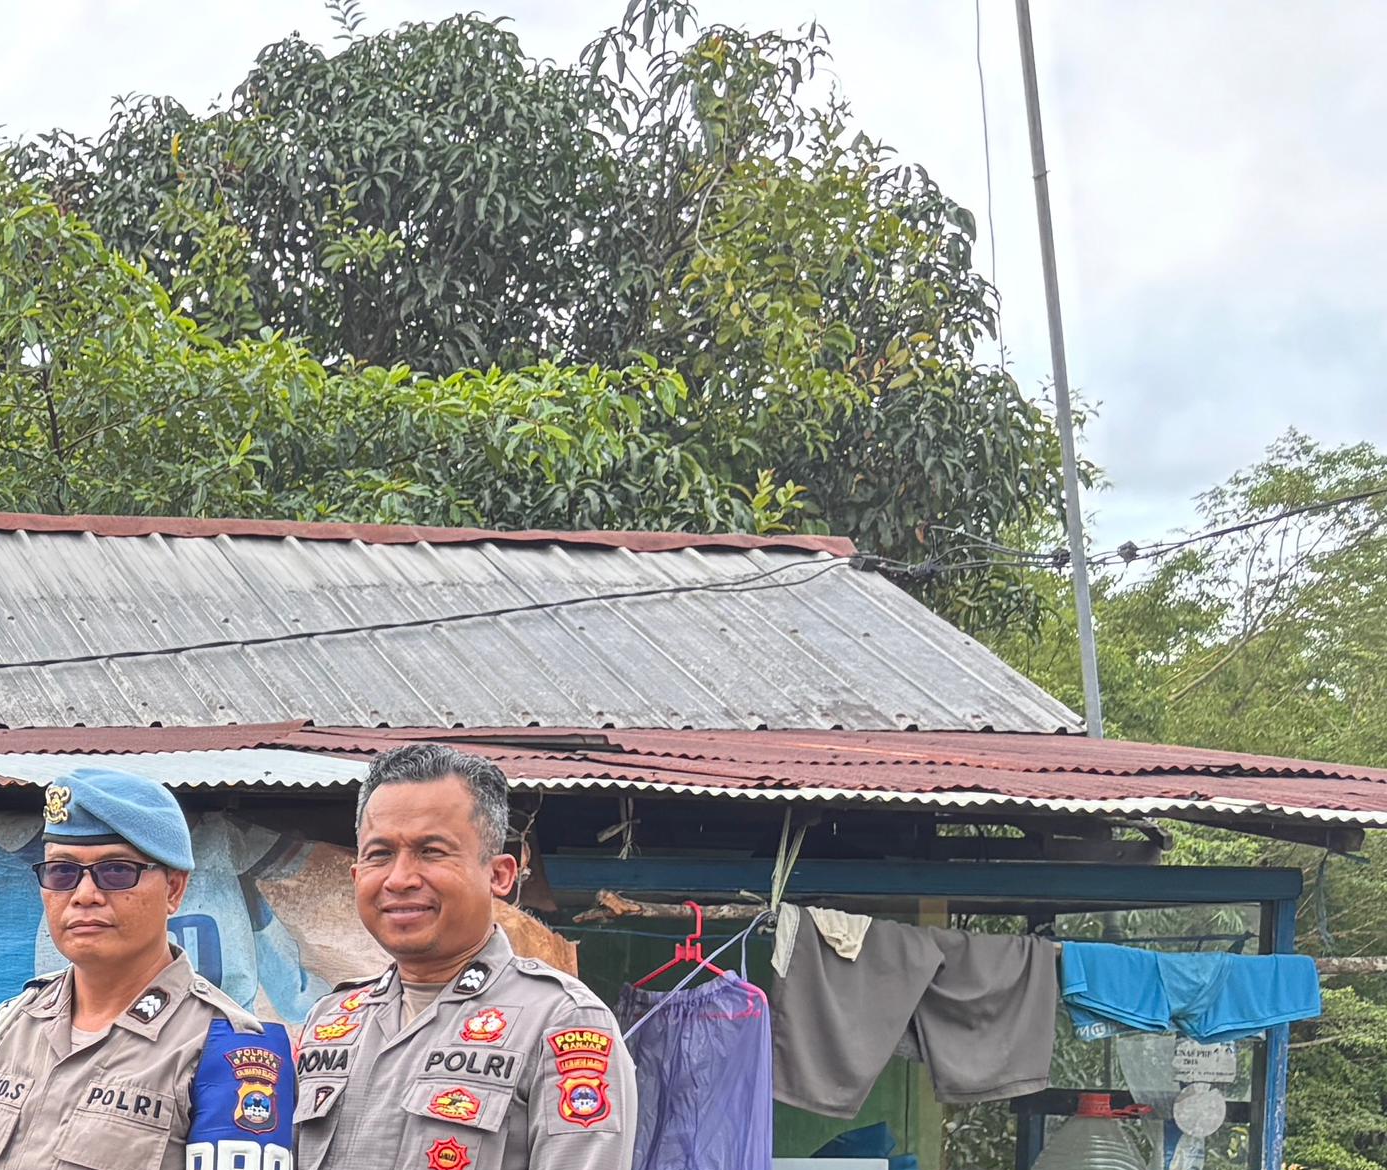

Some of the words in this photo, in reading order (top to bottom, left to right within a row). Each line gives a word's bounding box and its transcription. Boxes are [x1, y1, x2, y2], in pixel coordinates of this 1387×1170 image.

[555, 1032, 607, 1048] POLRES
[562, 1042, 602, 1051] BANJAR
[425, 1051, 515, 1079] POLRI
[88, 1087, 162, 1119] POLRI
